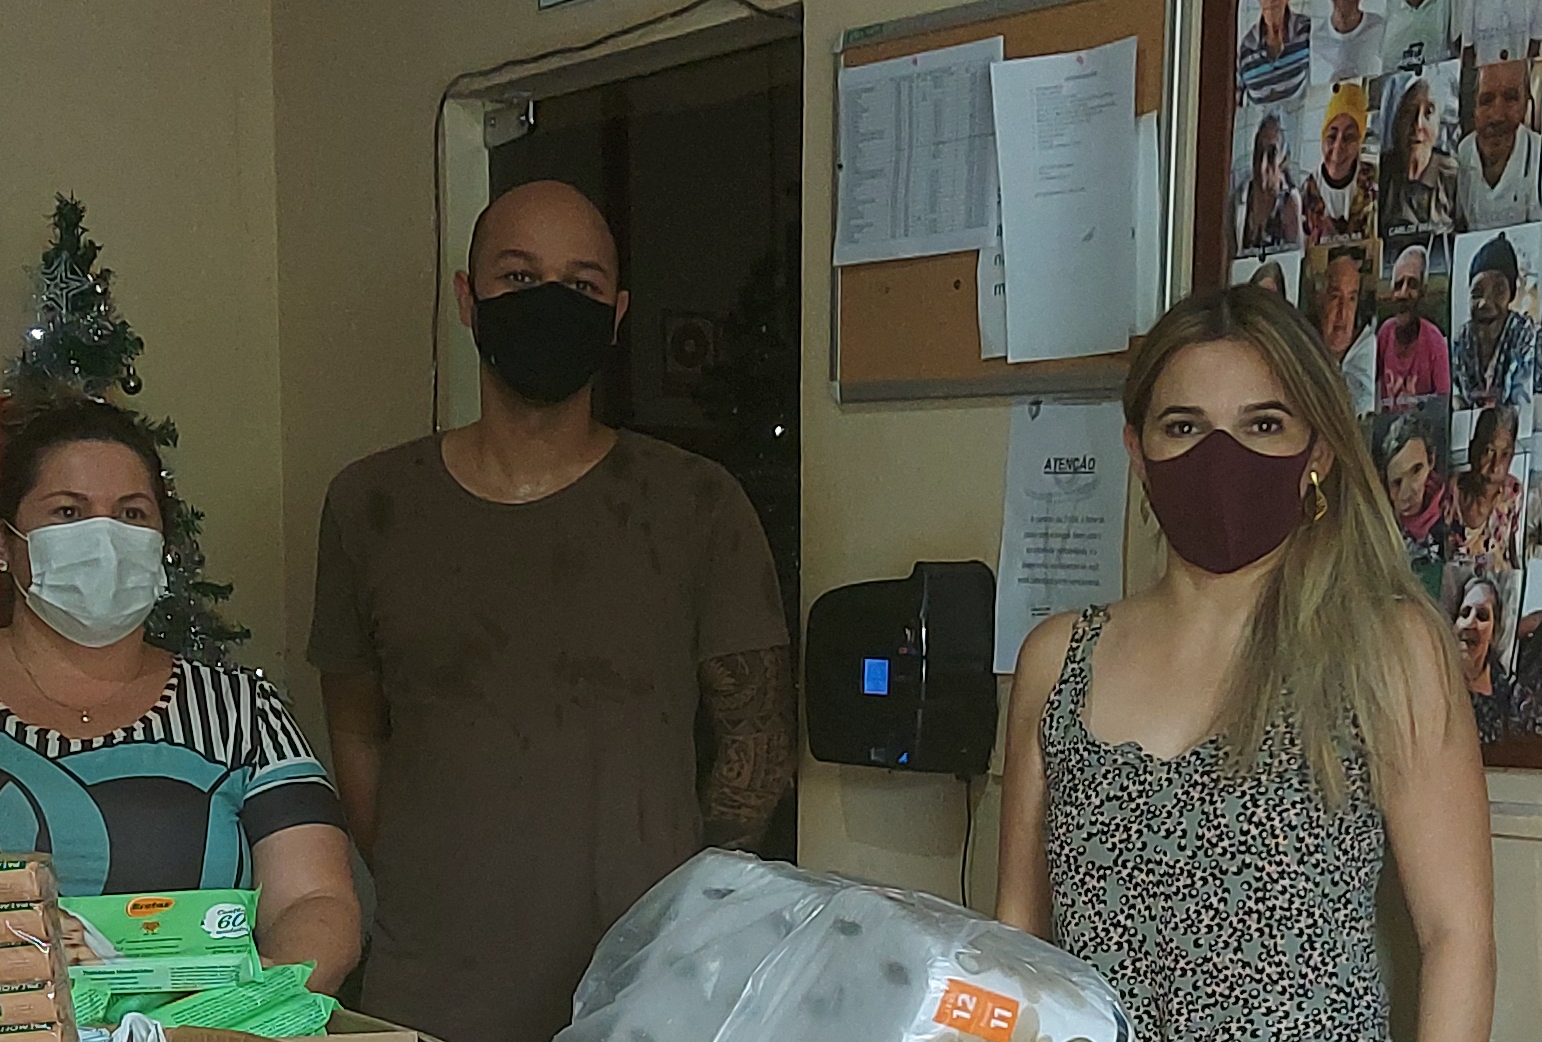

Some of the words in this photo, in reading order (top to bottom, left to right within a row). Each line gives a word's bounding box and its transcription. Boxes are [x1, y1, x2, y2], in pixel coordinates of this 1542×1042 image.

[1044, 455, 1096, 472] ATENÇÃO
[953, 993, 977, 1021] 12
[990, 1006, 1013, 1030] 11
